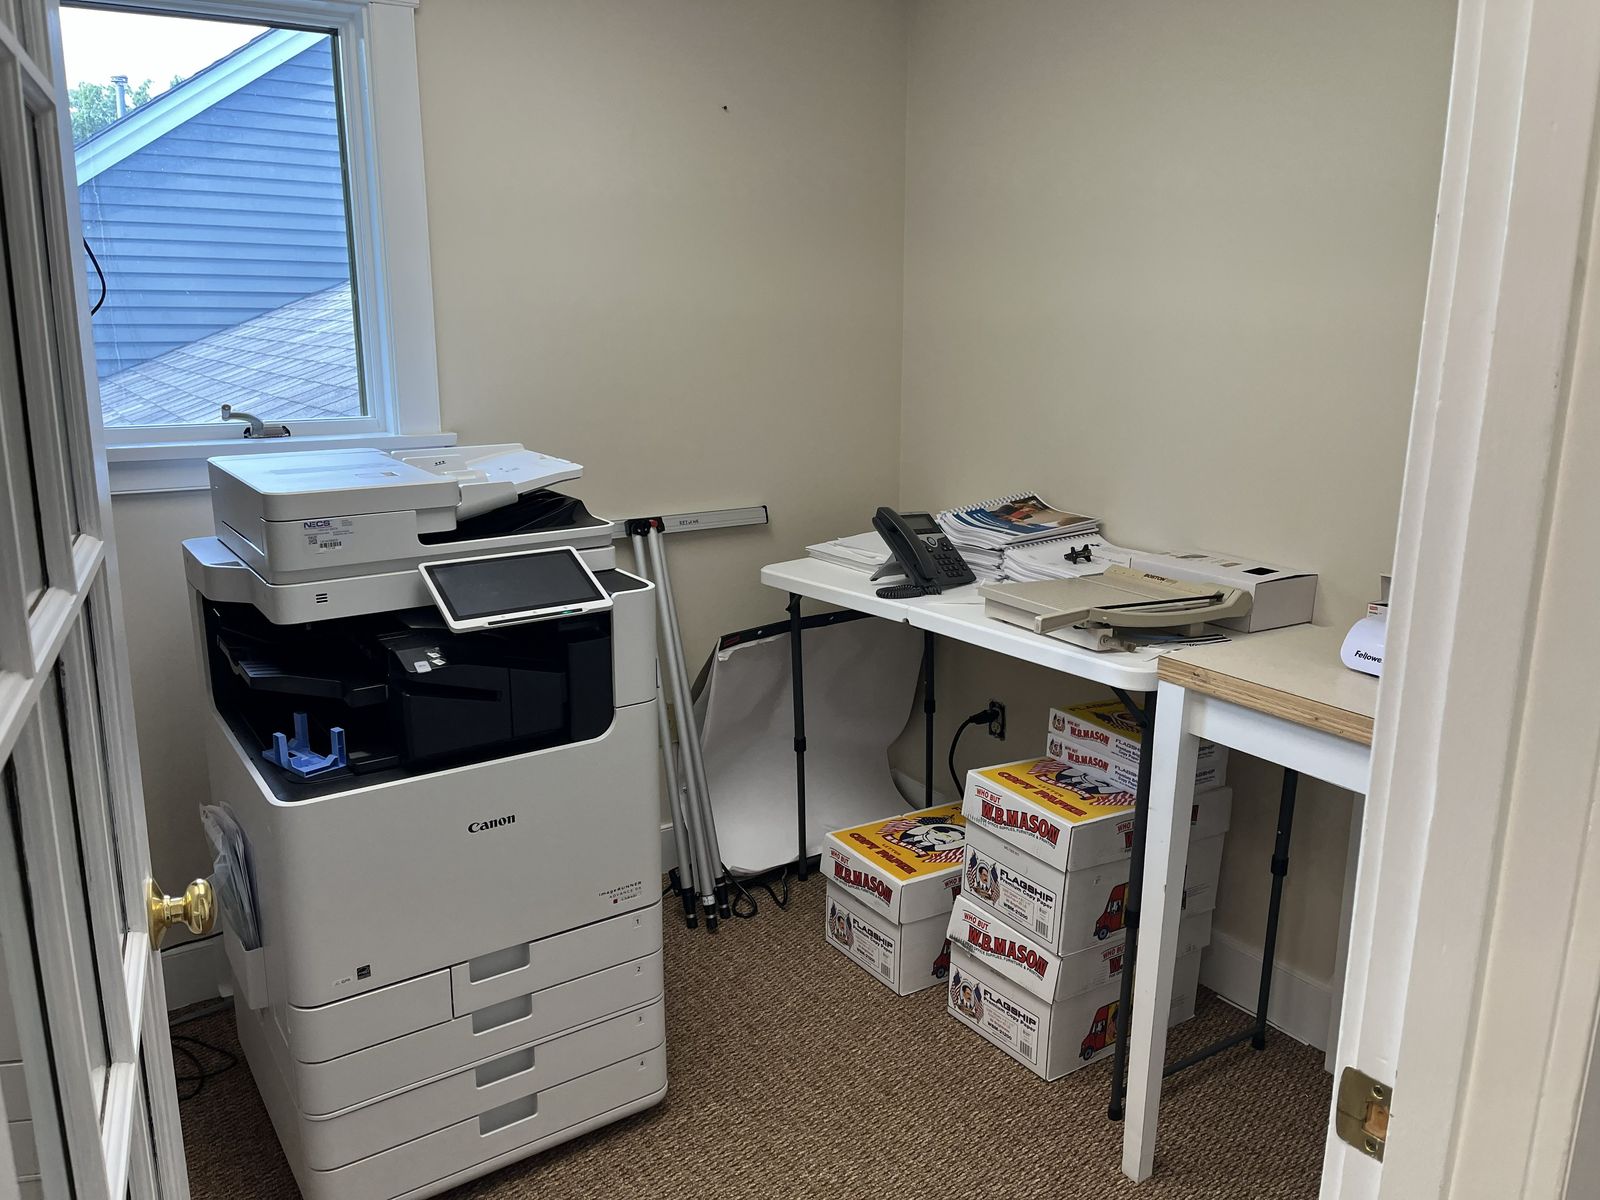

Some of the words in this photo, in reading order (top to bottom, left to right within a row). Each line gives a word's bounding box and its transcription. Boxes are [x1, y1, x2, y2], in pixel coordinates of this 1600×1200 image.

[304, 520, 330, 528] NECS
[1354, 650, 1383, 664] Fellowe
[976, 788, 988, 799] WHO
[988, 793, 1001, 804] BUT
[467, 814, 516, 833] Canon
[1000, 868, 1053, 902] FLAGSHIP
[1000, 876, 1021, 892] Premium
[1023, 890, 1035, 901] Copy
[1037, 898, 1052, 909] Paper
[853, 918, 893, 948] FLAGSHIP
[963, 912, 977, 924] WHO
[977, 919, 989, 930] BUT
[984, 988, 1036, 1025] FLAGSHIP
[984, 996, 1005, 1013] Premium
[1006, 1011, 1019, 1022] Copy
[1020, 1020, 1035, 1032] Paper
